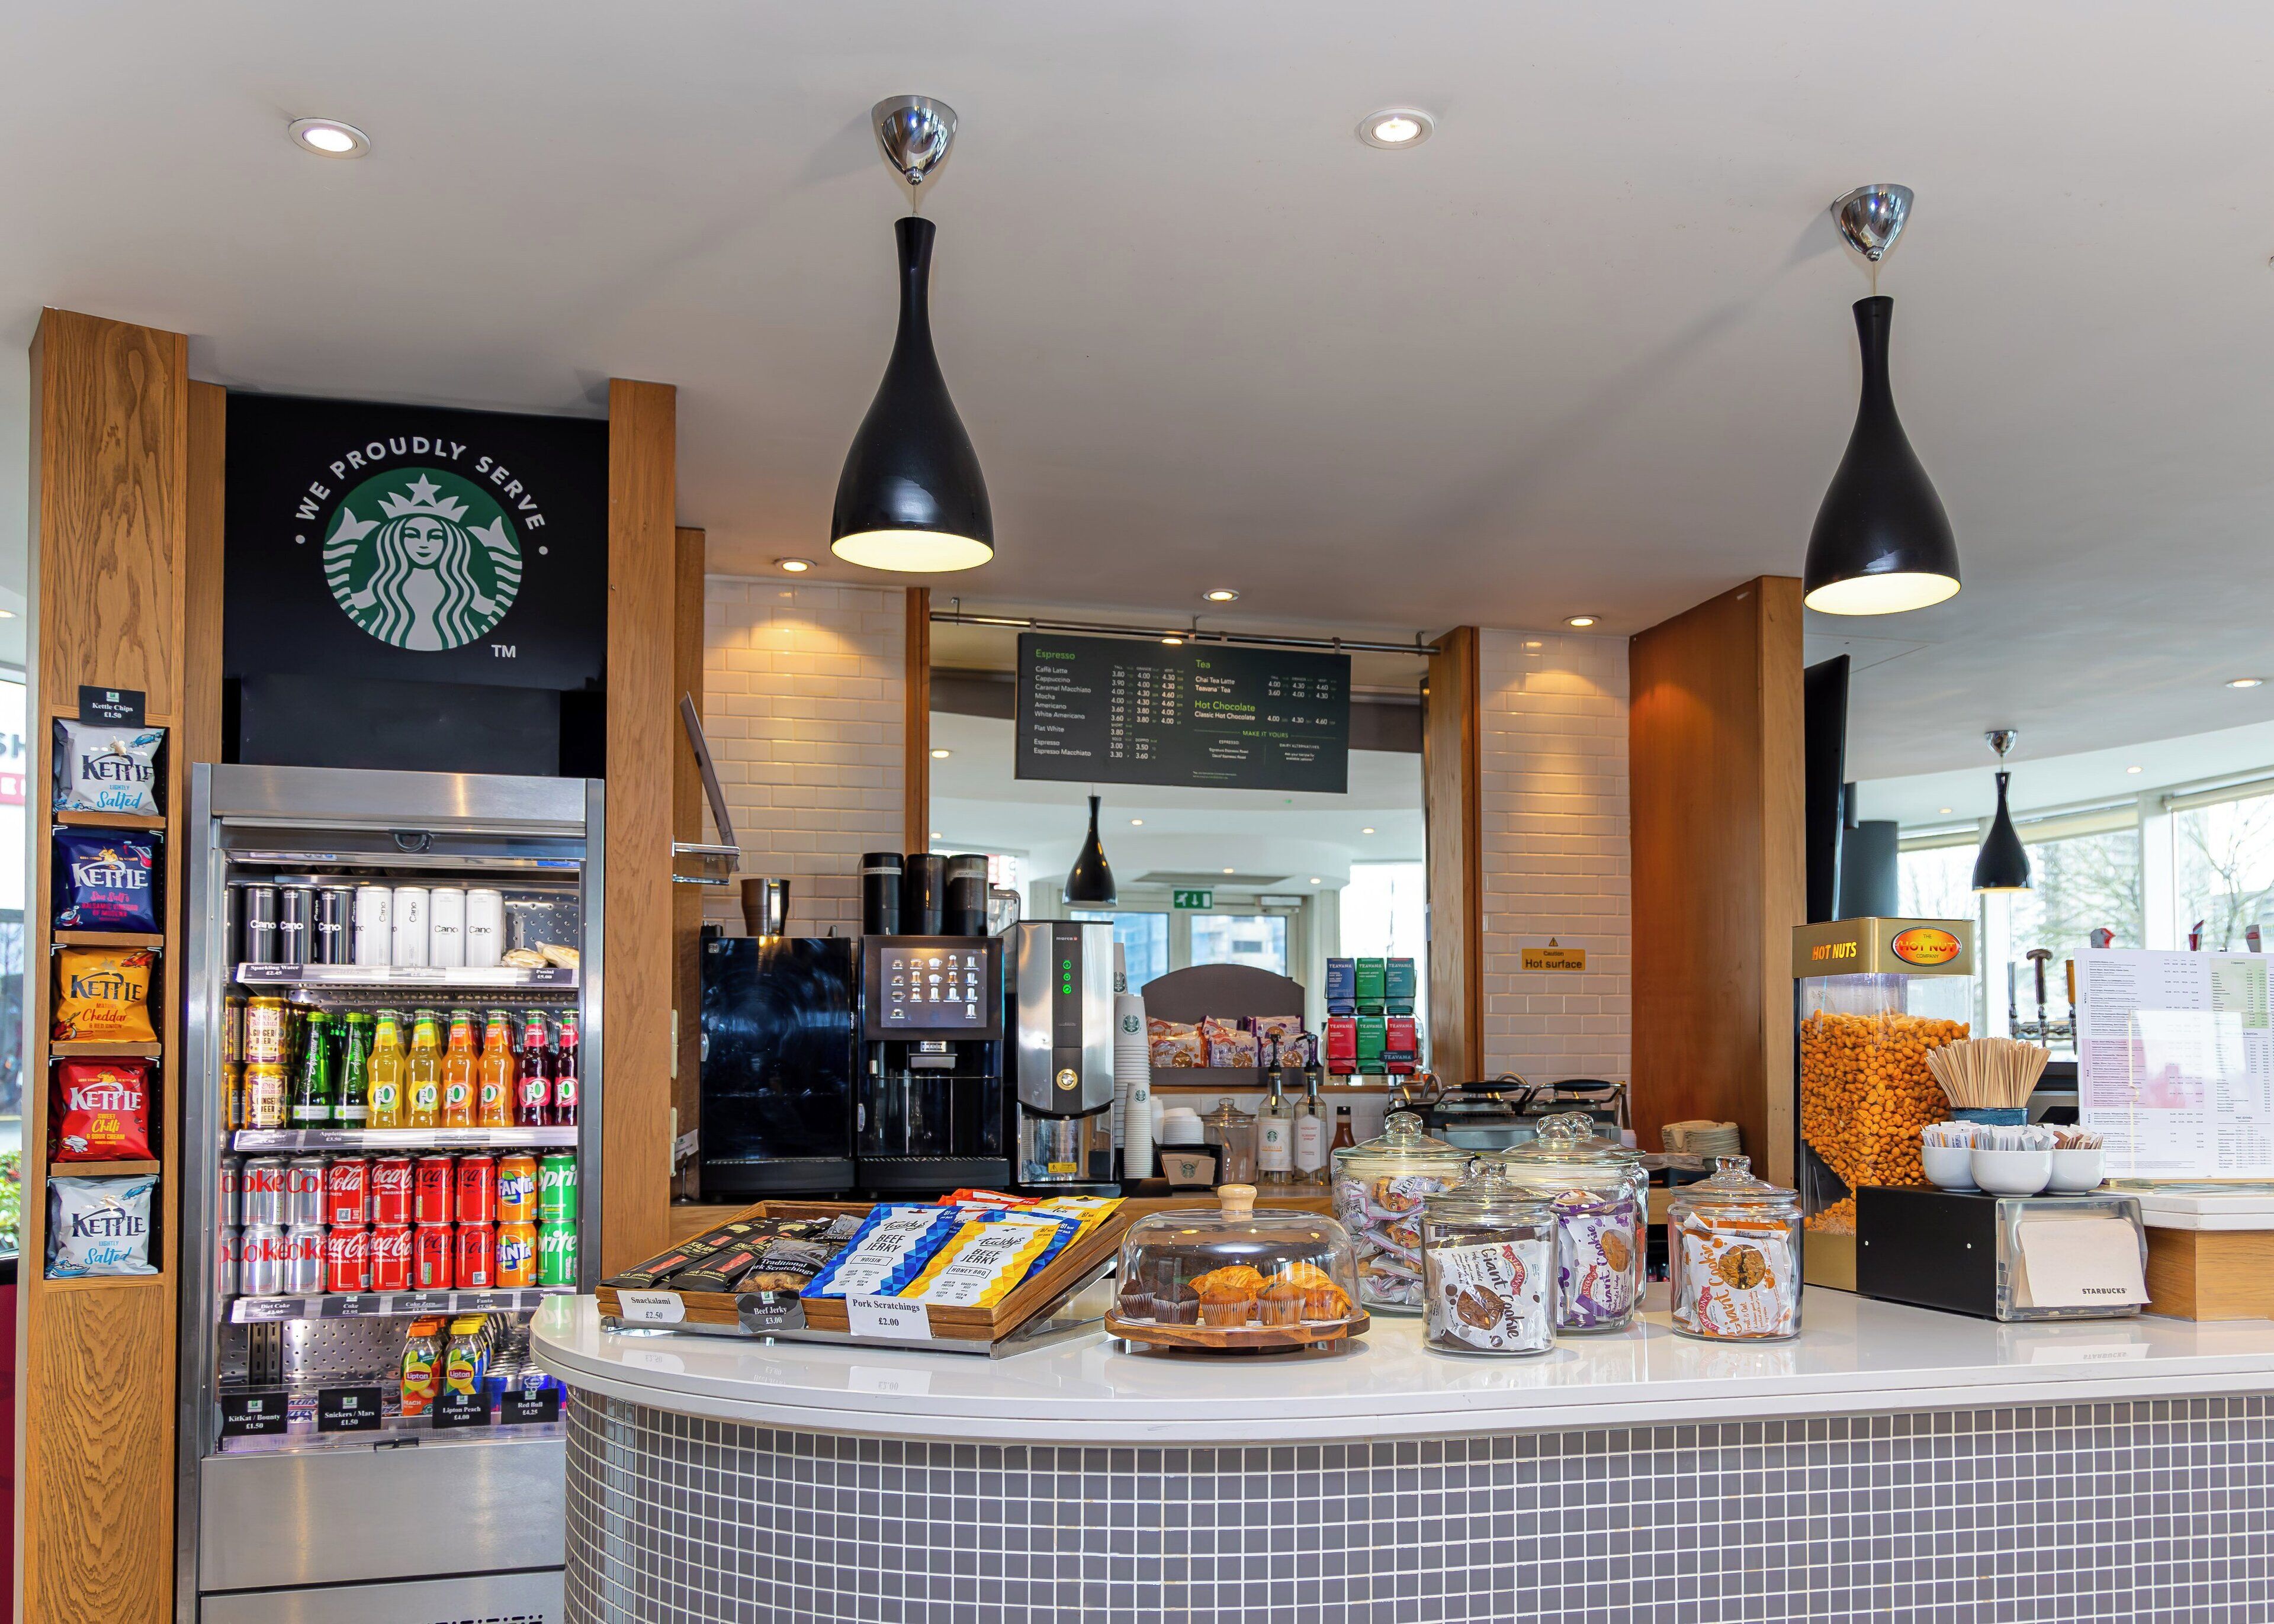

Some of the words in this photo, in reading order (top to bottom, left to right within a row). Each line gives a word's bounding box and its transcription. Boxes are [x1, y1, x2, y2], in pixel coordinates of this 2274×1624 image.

[296, 481, 330, 520] WE
[330, 436, 467, 480] PROUDLY
[475, 456, 545, 530] SERVE
[492, 645, 516, 658] TM
[1036, 649, 1075, 660] Espresso
[1196, 659, 1211, 668] Tea
[1035, 675, 1071, 683] Cappuccino
[114, 705, 133, 713] Chips
[1194, 700, 1210, 709] Hot
[1213, 701, 1255, 712] Chocolate
[81, 753, 153, 783] KETTLE
[97, 791, 142, 811] Salted
[72, 861, 148, 889] KETTLE
[250, 920, 277, 928] Cano
[280, 921, 304, 930] Cano
[319, 922, 342, 931] Cano
[1812, 944, 1831, 961] HOT
[1832, 941, 1857, 959] NUTS
[1899, 940, 1923, 951] HOT
[1929, 941, 1956, 953] NUT
[1525, 959, 1543, 969] Hot
[1546, 959, 1582, 969] surface
[70, 972, 142, 1002] KETTLE
[82, 1009, 127, 1023] Cheddar
[69, 1082, 142, 1111] KETTLE
[91, 1118, 120, 1133] Chilli
[498, 1176, 534, 1196] FANTA
[71, 1208, 146, 1237] KETTLE
[876, 1234, 906, 1243] BEEF
[864, 1243, 902, 1253] JERKY
[1587, 1225, 1608, 1266] Cookie
[85, 1247, 132, 1265] Salted
[496, 1242, 531, 1262] FANTA
[971, 1249, 1003, 1257] BEEF
[762, 1258, 808, 1268] Traditional
[960, 1255, 999, 1265] JERKY
[765, 1265, 814, 1275] Scratchings
[1481, 1248, 1508, 1290] Giant
[1499, 1294, 1525, 1339] Cookie
[631, 1297, 671, 1305] Snackalami
[852, 1299, 872, 1308] Pork
[873, 1301, 920, 1313] Scratchings
[645, 1311, 663, 1320] £2.50
[770, 1306, 787, 1315] Jerky
[1714, 1288, 1743, 1336] Giant
[878, 1317, 900, 1327] £2.00
[257, 1414, 281, 1422] Bounty
